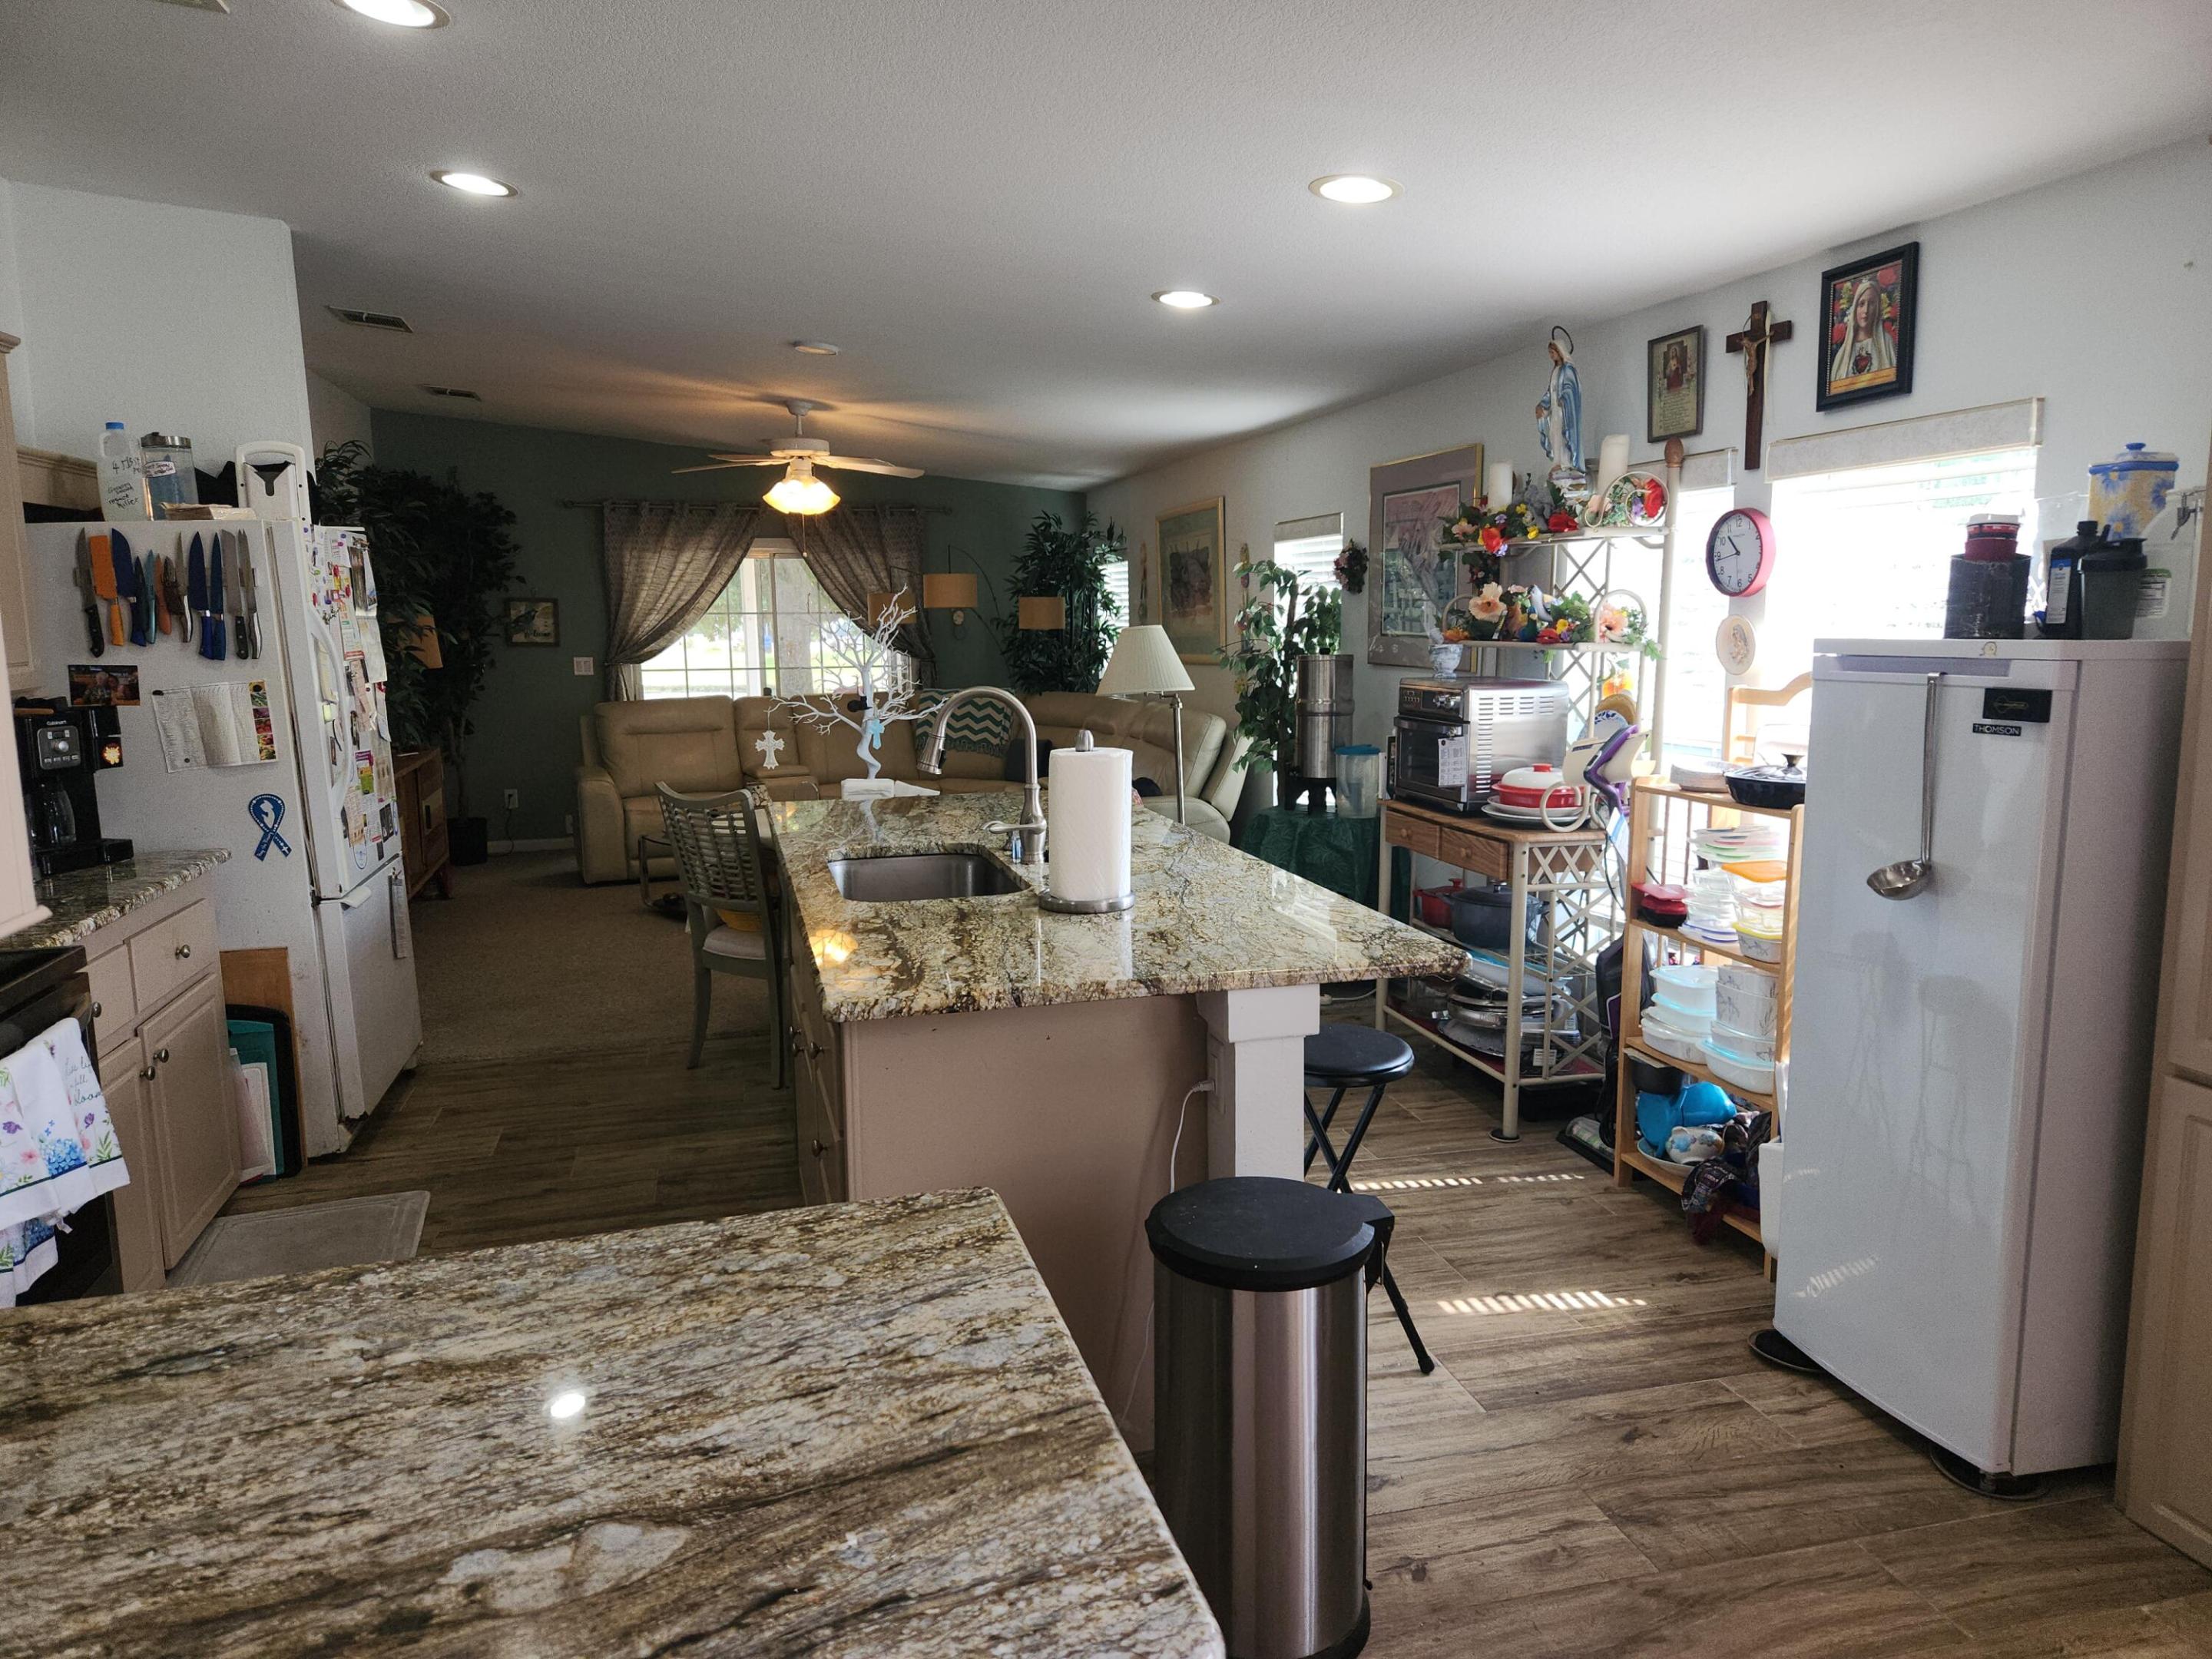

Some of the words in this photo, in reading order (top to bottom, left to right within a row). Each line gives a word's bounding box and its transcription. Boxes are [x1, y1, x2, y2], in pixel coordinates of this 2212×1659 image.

[1736, 516, 1743, 528] 12
[1719, 536, 1727, 546] 10
[1737, 578, 1742, 588] 6
[1973, 724, 2020, 735] THOMSON
